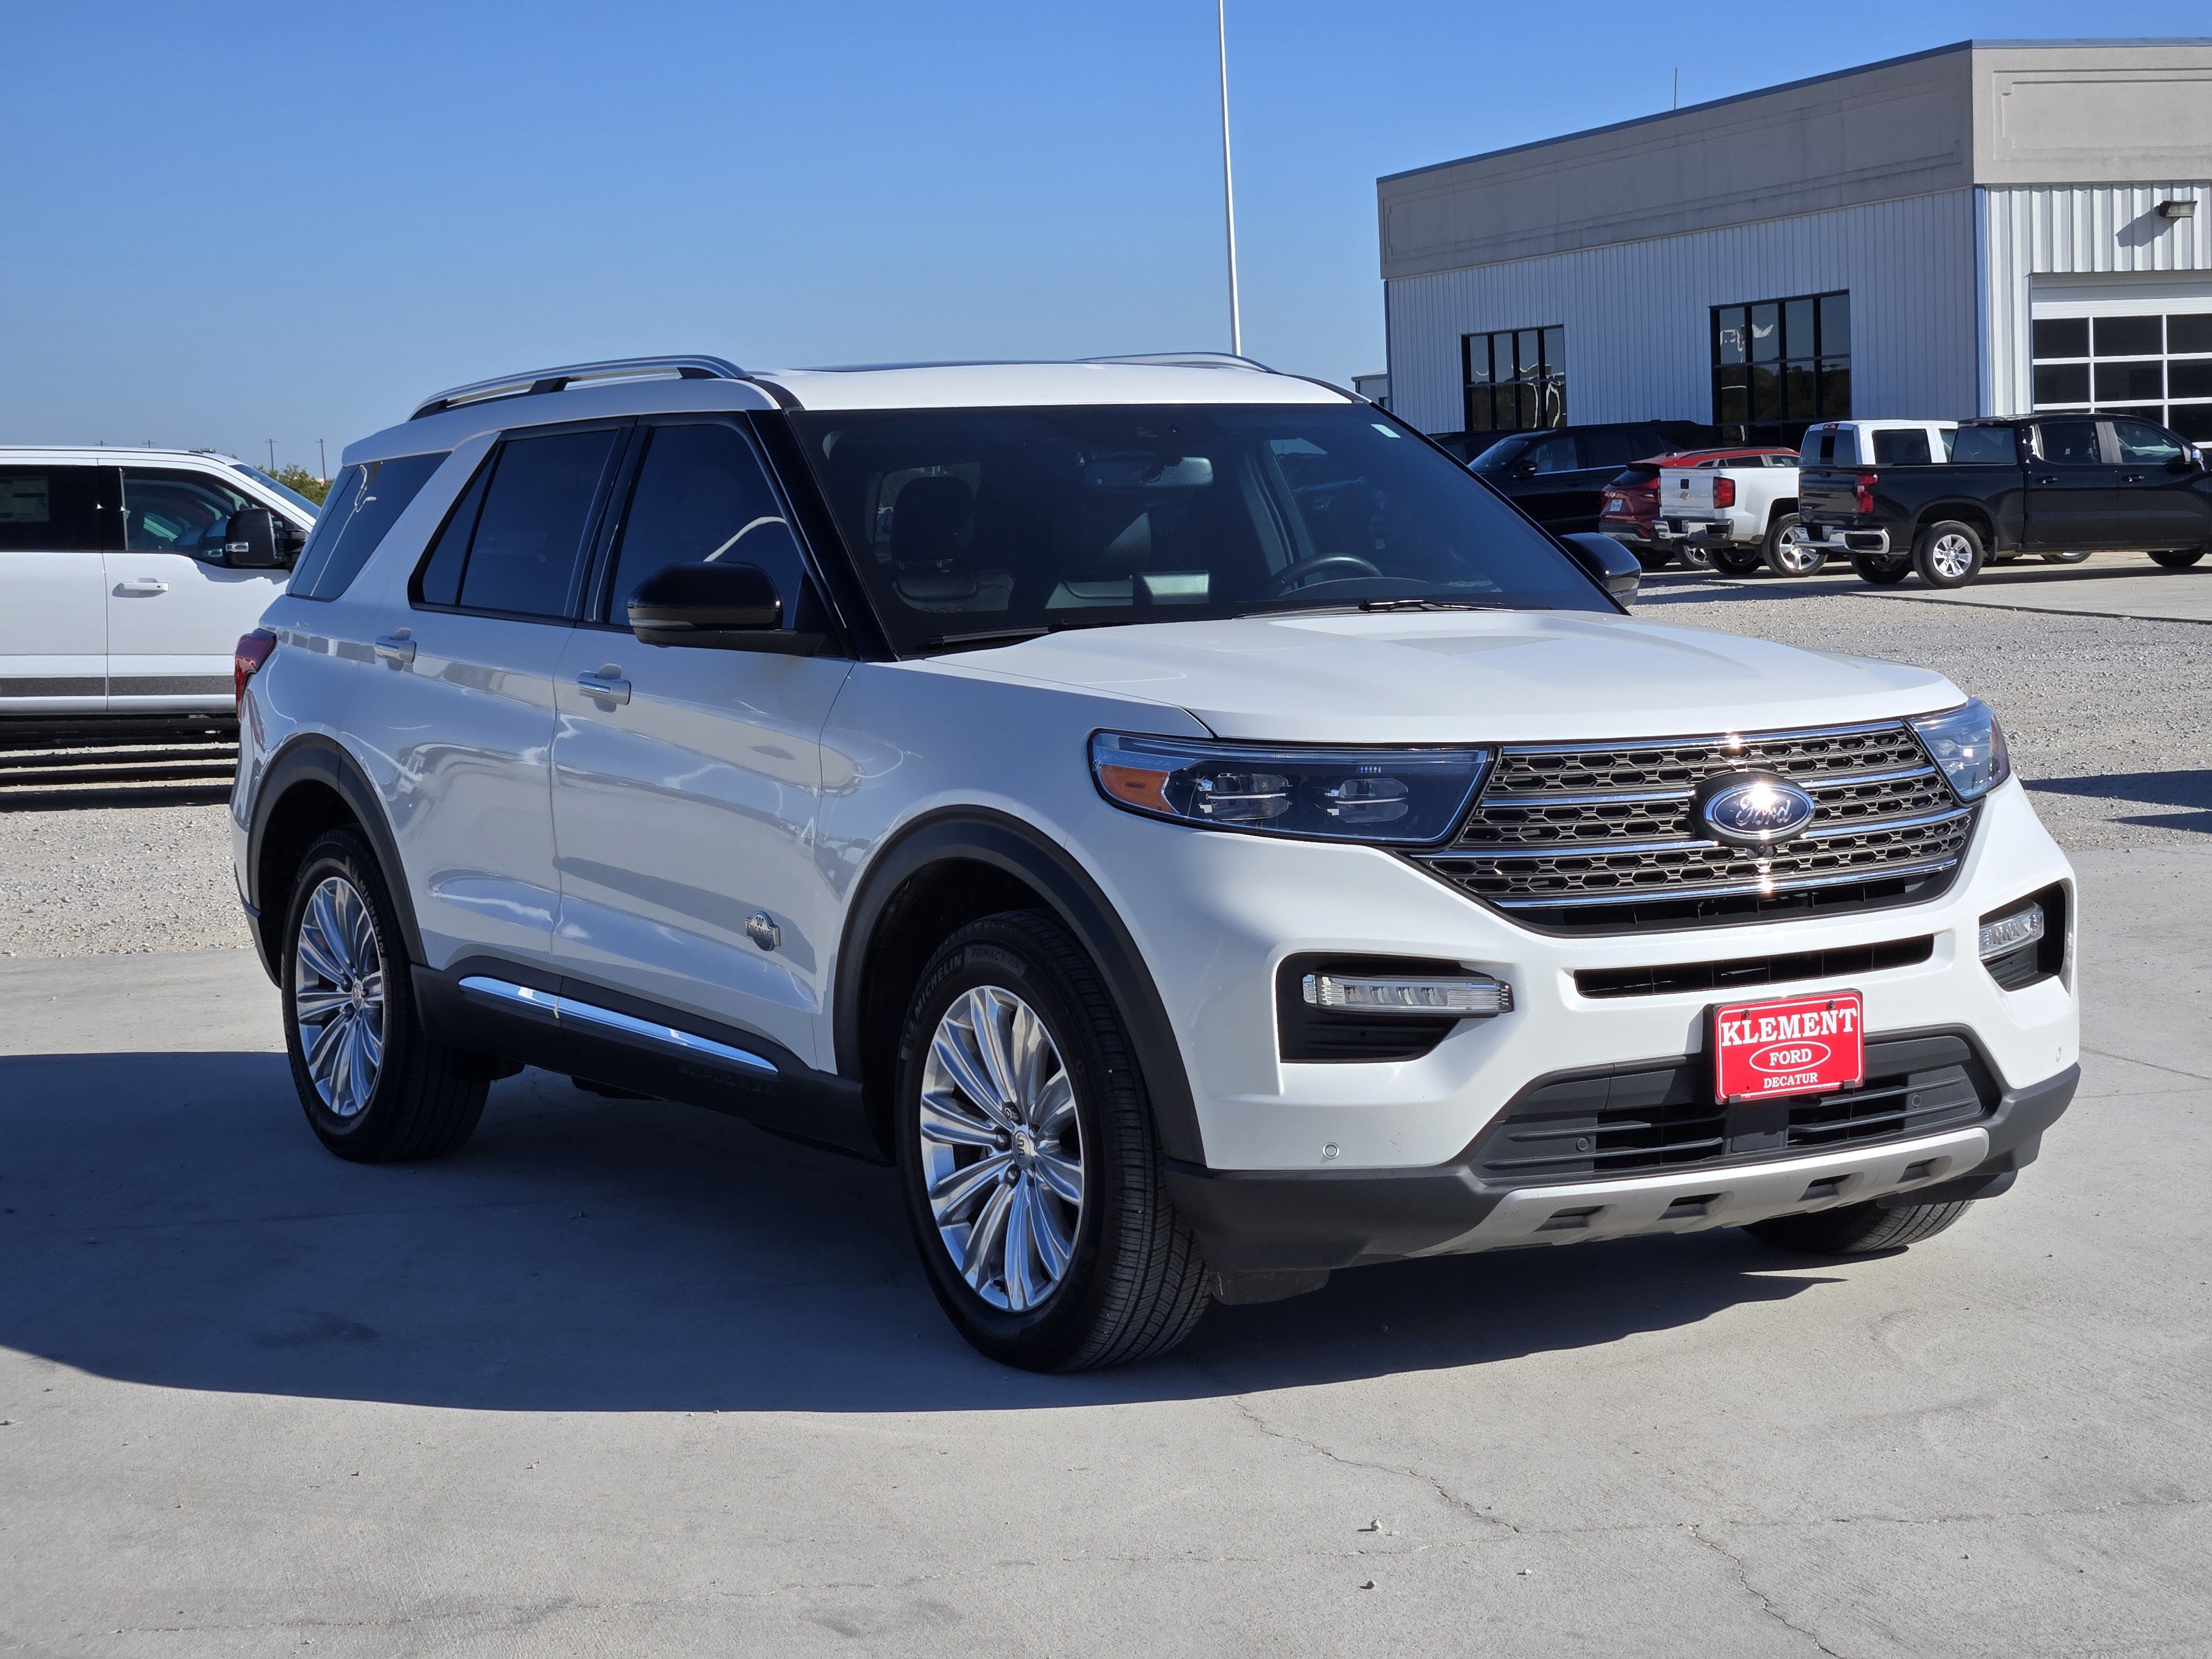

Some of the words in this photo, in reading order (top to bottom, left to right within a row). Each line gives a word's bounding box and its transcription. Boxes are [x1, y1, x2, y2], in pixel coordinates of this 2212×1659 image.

[1735, 795, 1792, 827] Ford
[915, 953, 962, 1019] MICHELIN
[972, 948, 1006, 963] PRIMACY
[1721, 1007, 1858, 1047] KLEMENT
[1769, 1048, 1812, 1066] FORD
[1764, 1072, 1818, 1089] DECATUR
